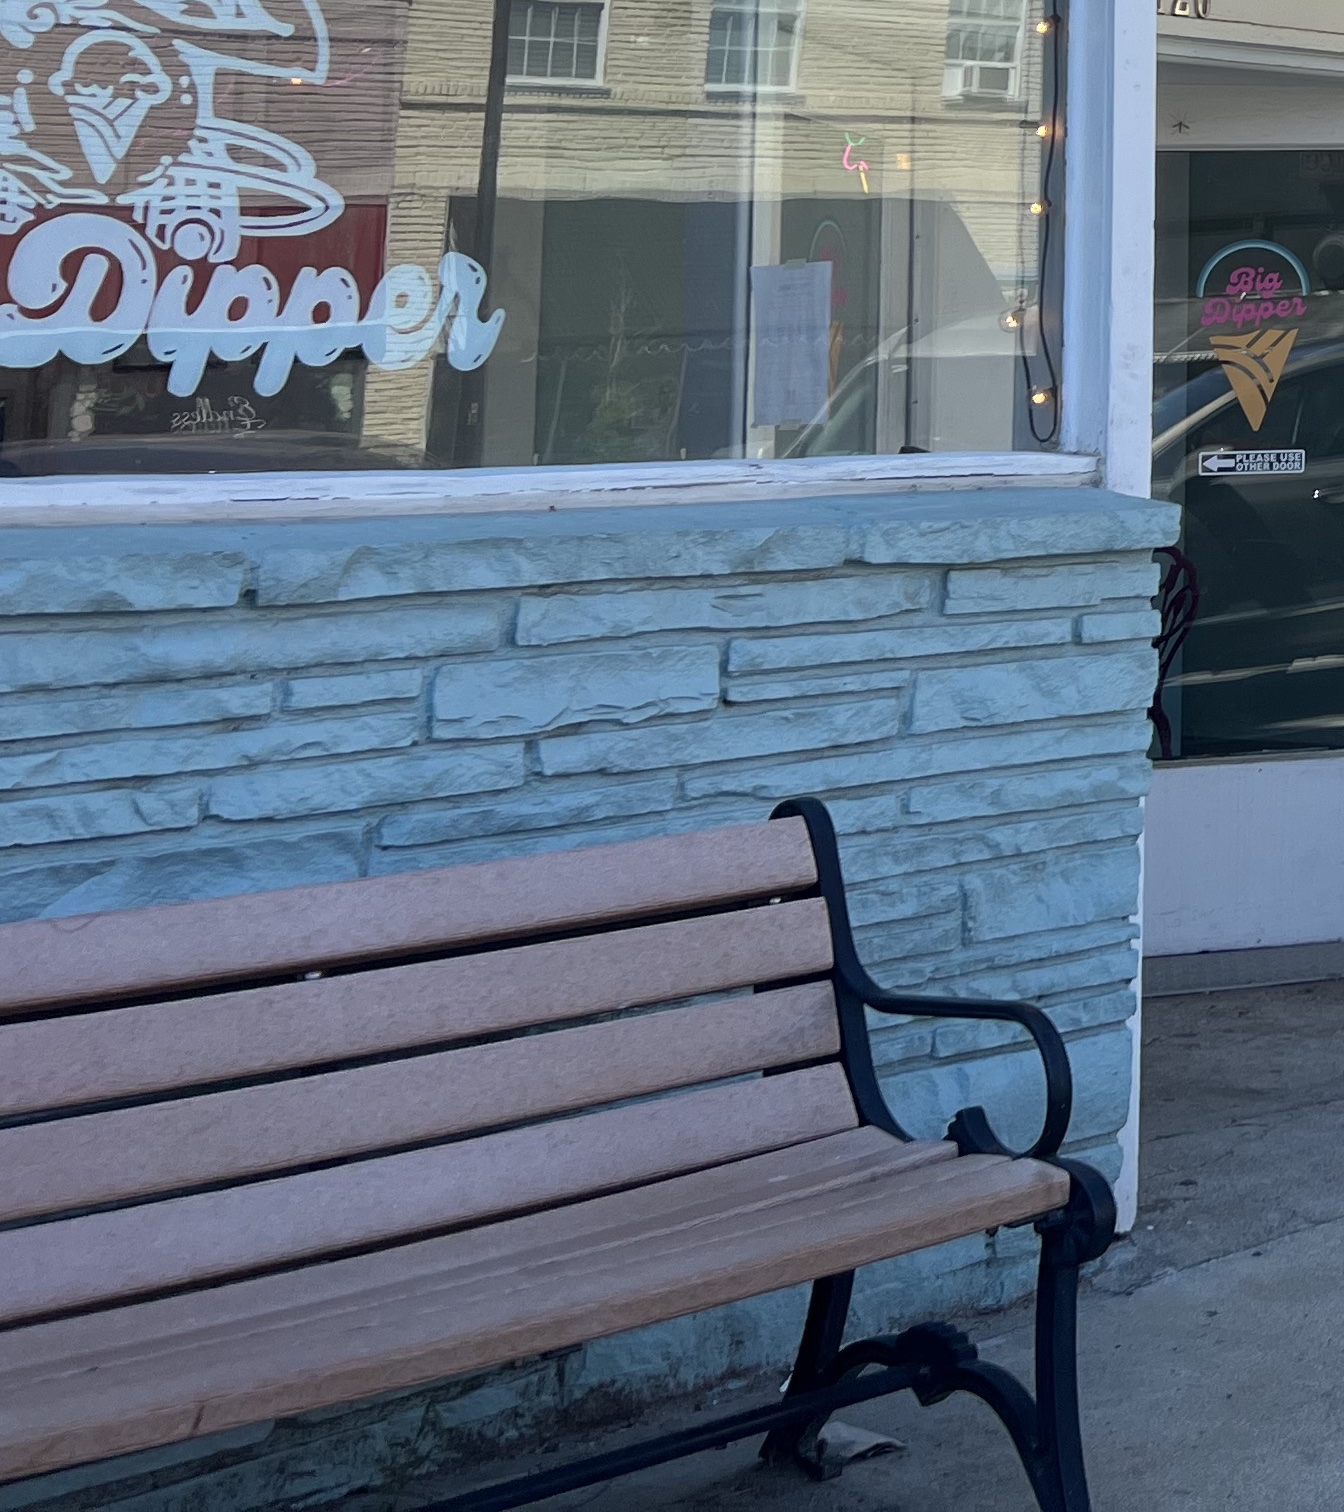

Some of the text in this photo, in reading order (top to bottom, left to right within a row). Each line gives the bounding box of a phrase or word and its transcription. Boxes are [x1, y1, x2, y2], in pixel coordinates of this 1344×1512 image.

[1226, 266, 1283, 299] Big
[0, 213, 506, 397] Dipper
[1201, 296, 1307, 329] Dipper
[1236, 453, 1301, 462] PLEASE USE
[1236, 462, 1301, 471] OTHER DOOR
